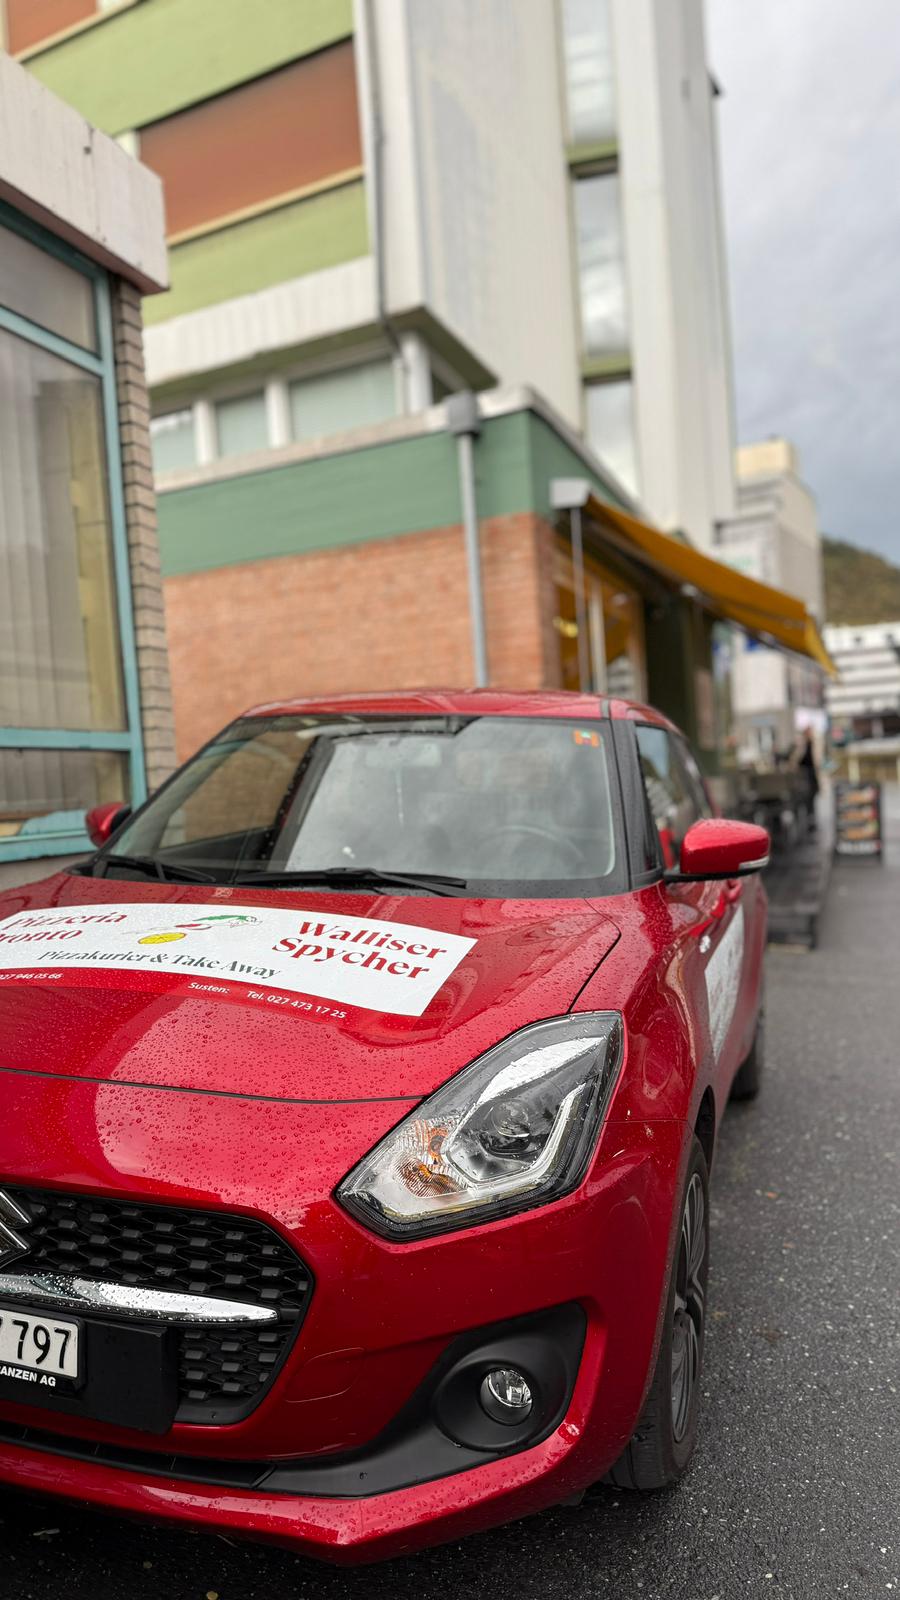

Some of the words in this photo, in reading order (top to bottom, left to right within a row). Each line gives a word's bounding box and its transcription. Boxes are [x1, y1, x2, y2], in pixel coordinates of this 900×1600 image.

[2, 911, 127, 930] Pizzeria
[0, 930, 83, 943] ronto
[299, 921, 447, 960] Walliser
[37, 950, 150, 962] Pizzakurier
[150, 953, 169, 963] &
[171, 954, 220, 969] Take
[221, 961, 281, 979] Away
[272, 937, 430, 979] Spycher
[188, 982, 230, 994] Susten:
[247, 990, 264, 1000] Tel.
[267, 995, 290, 1005] 027
[290, 1000, 313, 1011] 473
[315, 1005, 330, 1014] 17
[330, 1009, 347, 1019] 25
[0, 1366, 38, 1383] ANZEN
[39, 1375, 57, 1388] AG
